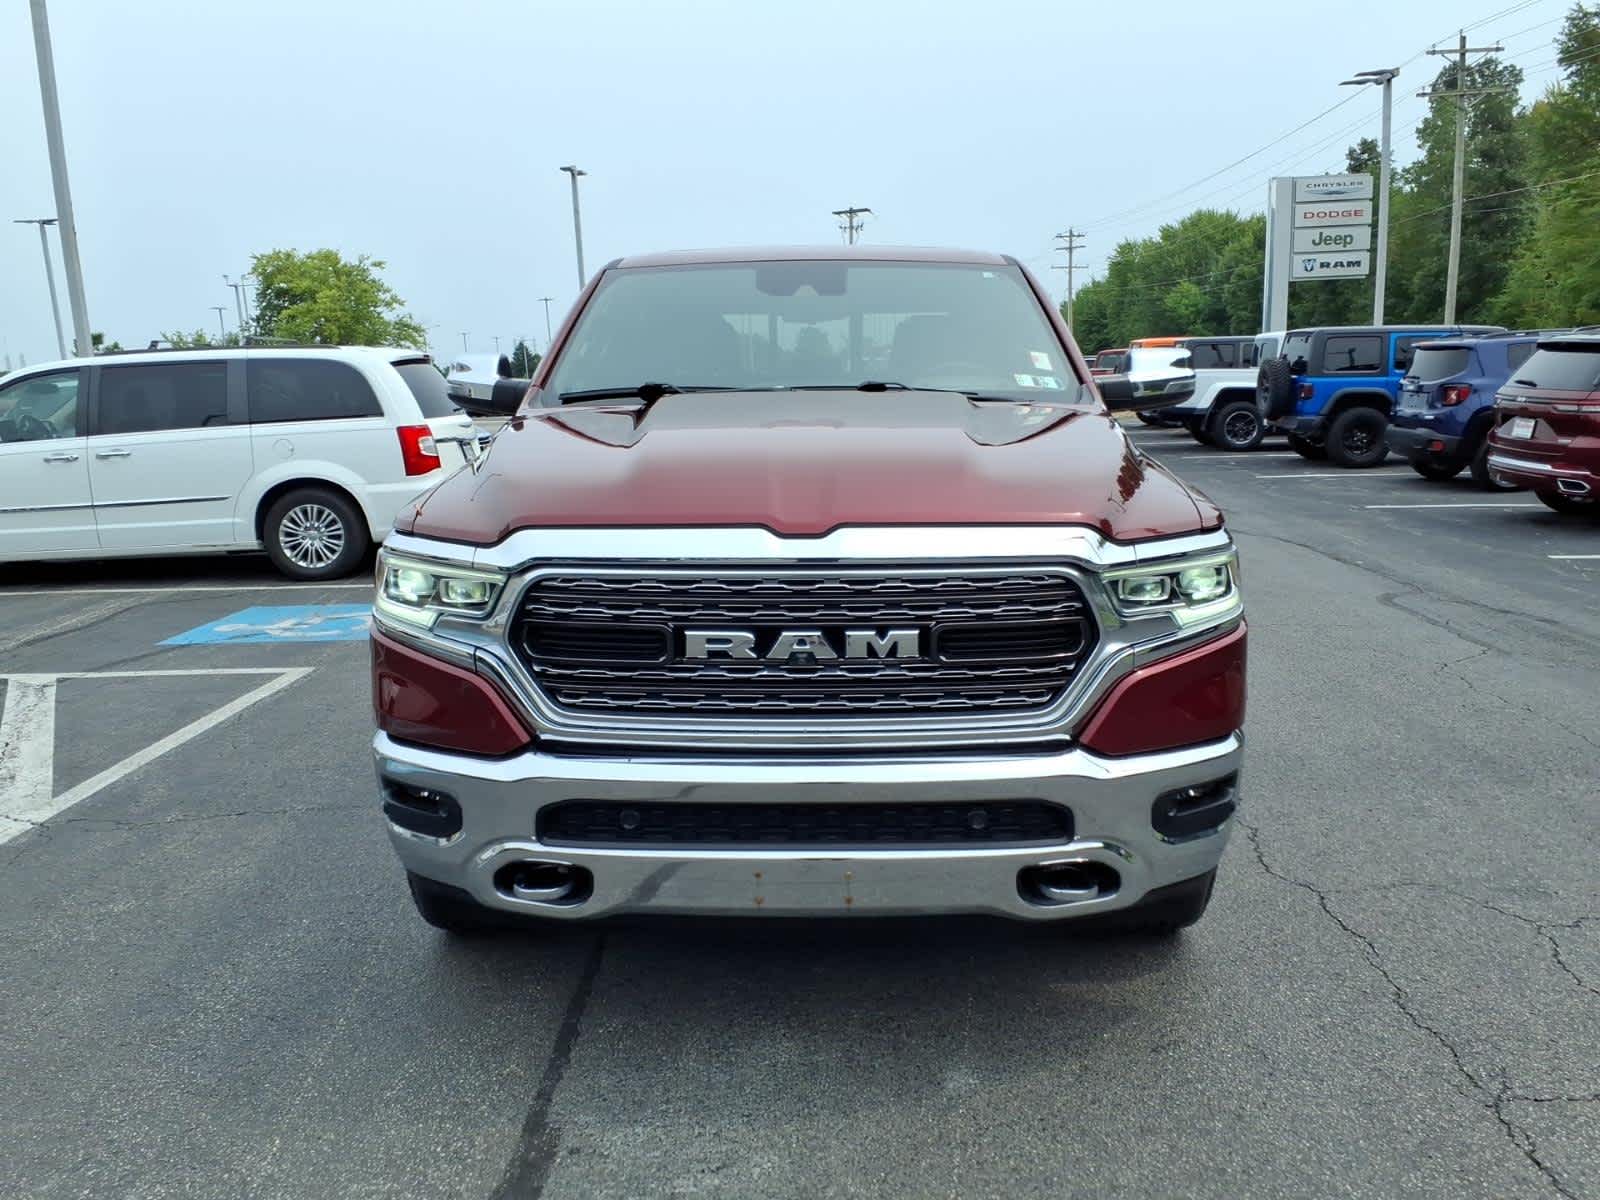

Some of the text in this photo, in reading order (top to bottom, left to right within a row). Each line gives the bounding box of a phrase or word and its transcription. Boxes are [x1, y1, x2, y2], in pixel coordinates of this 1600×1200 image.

[1306, 181, 1364, 189] CHRYSLER
[1303, 209, 1364, 219] DODGE
[1311, 231, 1354, 248] Jeep
[1319, 260, 1361, 269] RAM
[684, 630, 920, 659] RAM
